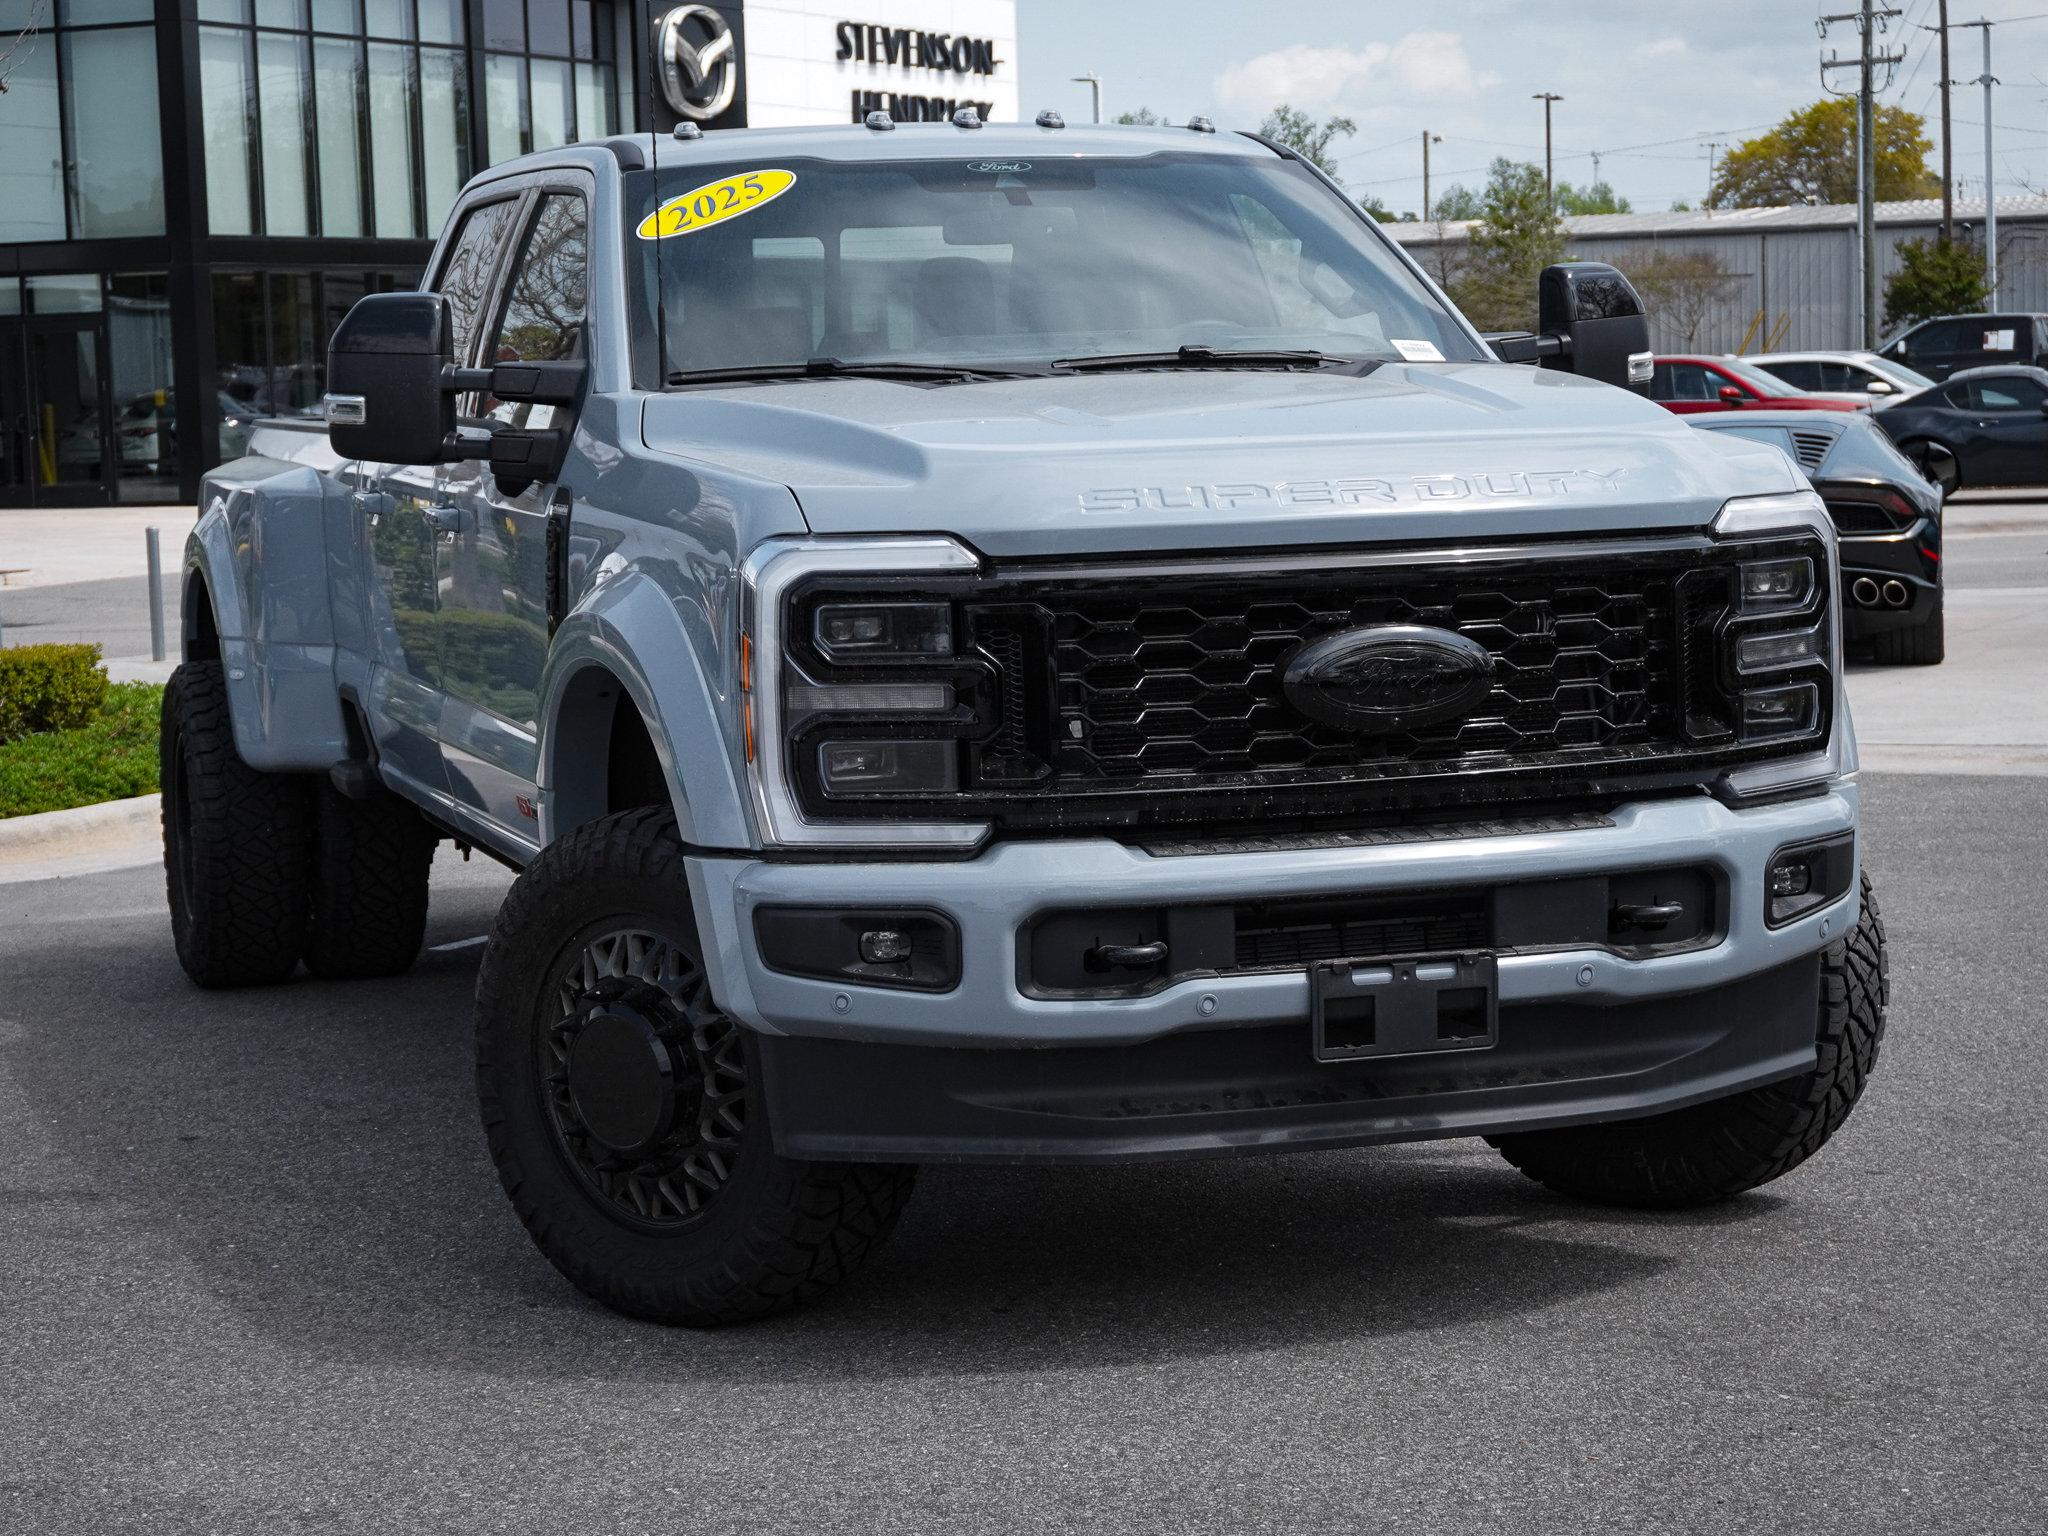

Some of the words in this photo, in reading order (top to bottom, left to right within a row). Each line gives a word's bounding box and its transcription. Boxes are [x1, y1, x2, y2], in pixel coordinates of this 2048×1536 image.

[980, 161, 1020, 172] Ford
[668, 174, 764, 232] 2025
[1078, 479, 1397, 514] SUPER
[1411, 467, 1627, 501] DUTY
[1350, 656, 1443, 696] Ford
